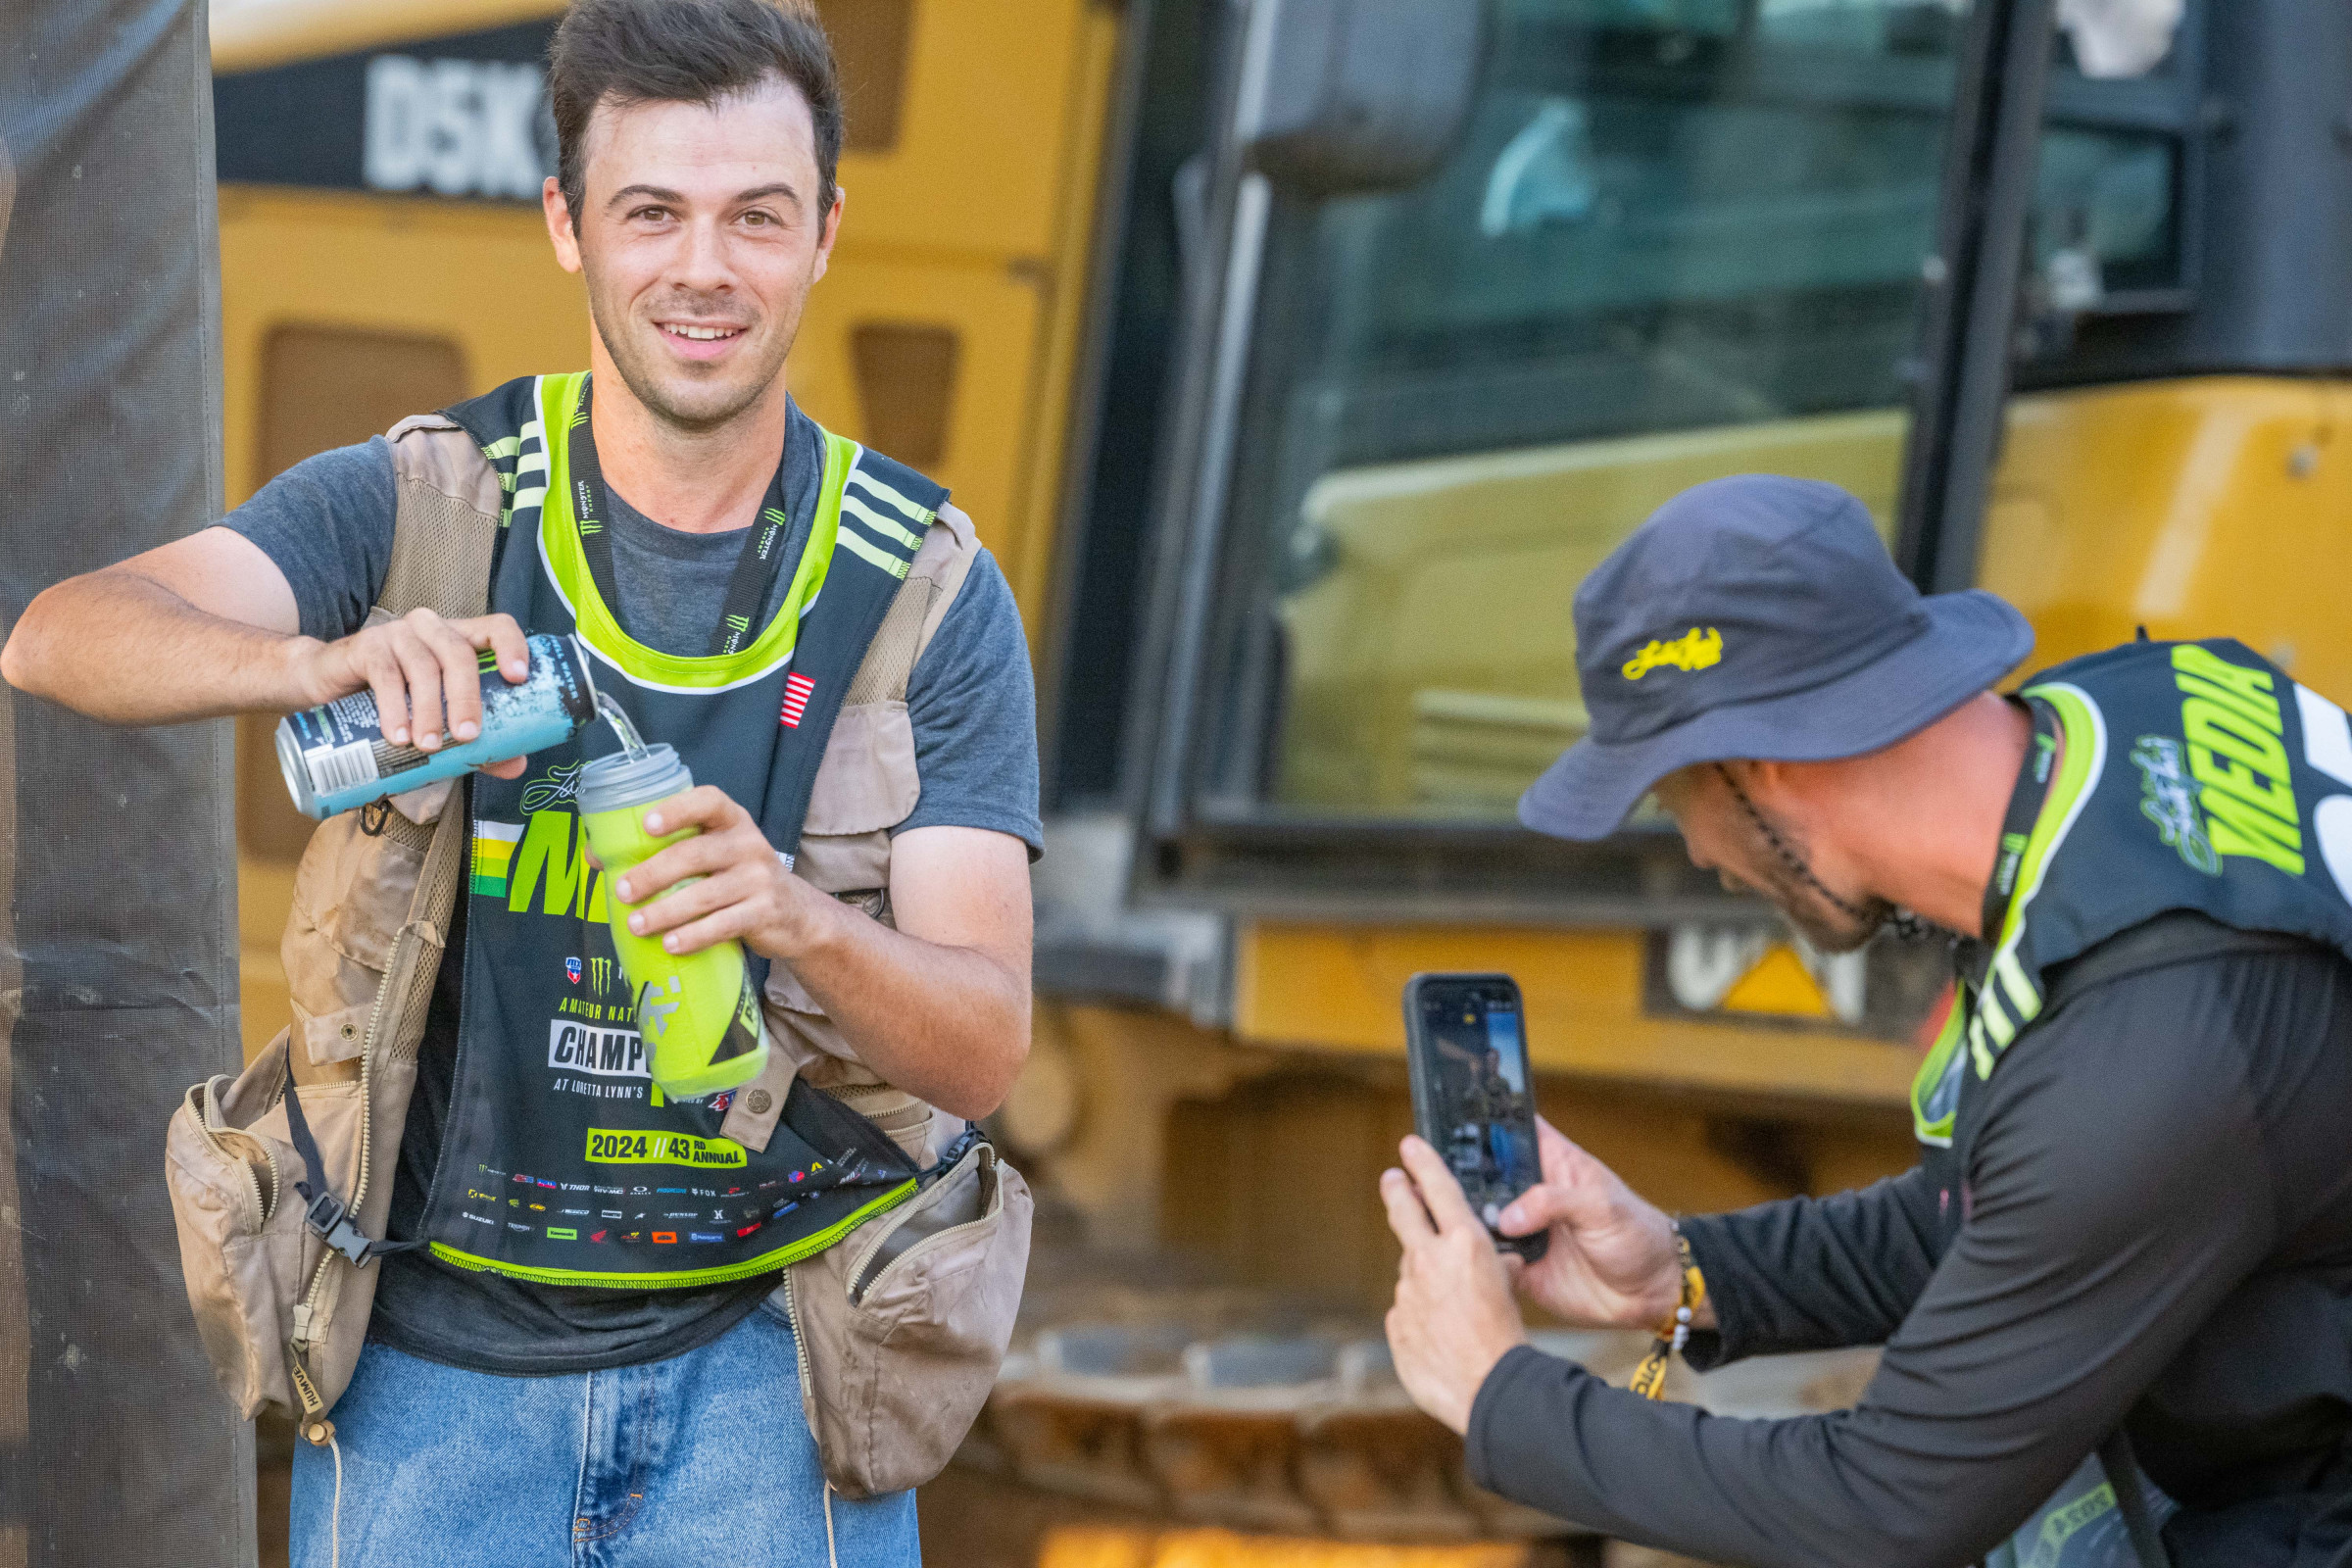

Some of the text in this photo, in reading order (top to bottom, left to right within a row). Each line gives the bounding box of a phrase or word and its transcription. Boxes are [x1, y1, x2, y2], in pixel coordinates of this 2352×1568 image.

[727, 631, 741, 655] MONS
[561, 661, 579, 700] WATER
[2171, 644, 2305, 875] MEDIA
[559, 998, 637, 1023] AMATEUR NAT
[554, 1025, 647, 1072] CHAMP
[553, 1078, 644, 1100] AT LORETTA LYNN'S
[591, 1134, 648, 1158] 2024
[693, 1150, 742, 1164] ANNUAL
[694, 1141, 706, 1150] RD
[468, 1213, 495, 1225] SUZUKI
